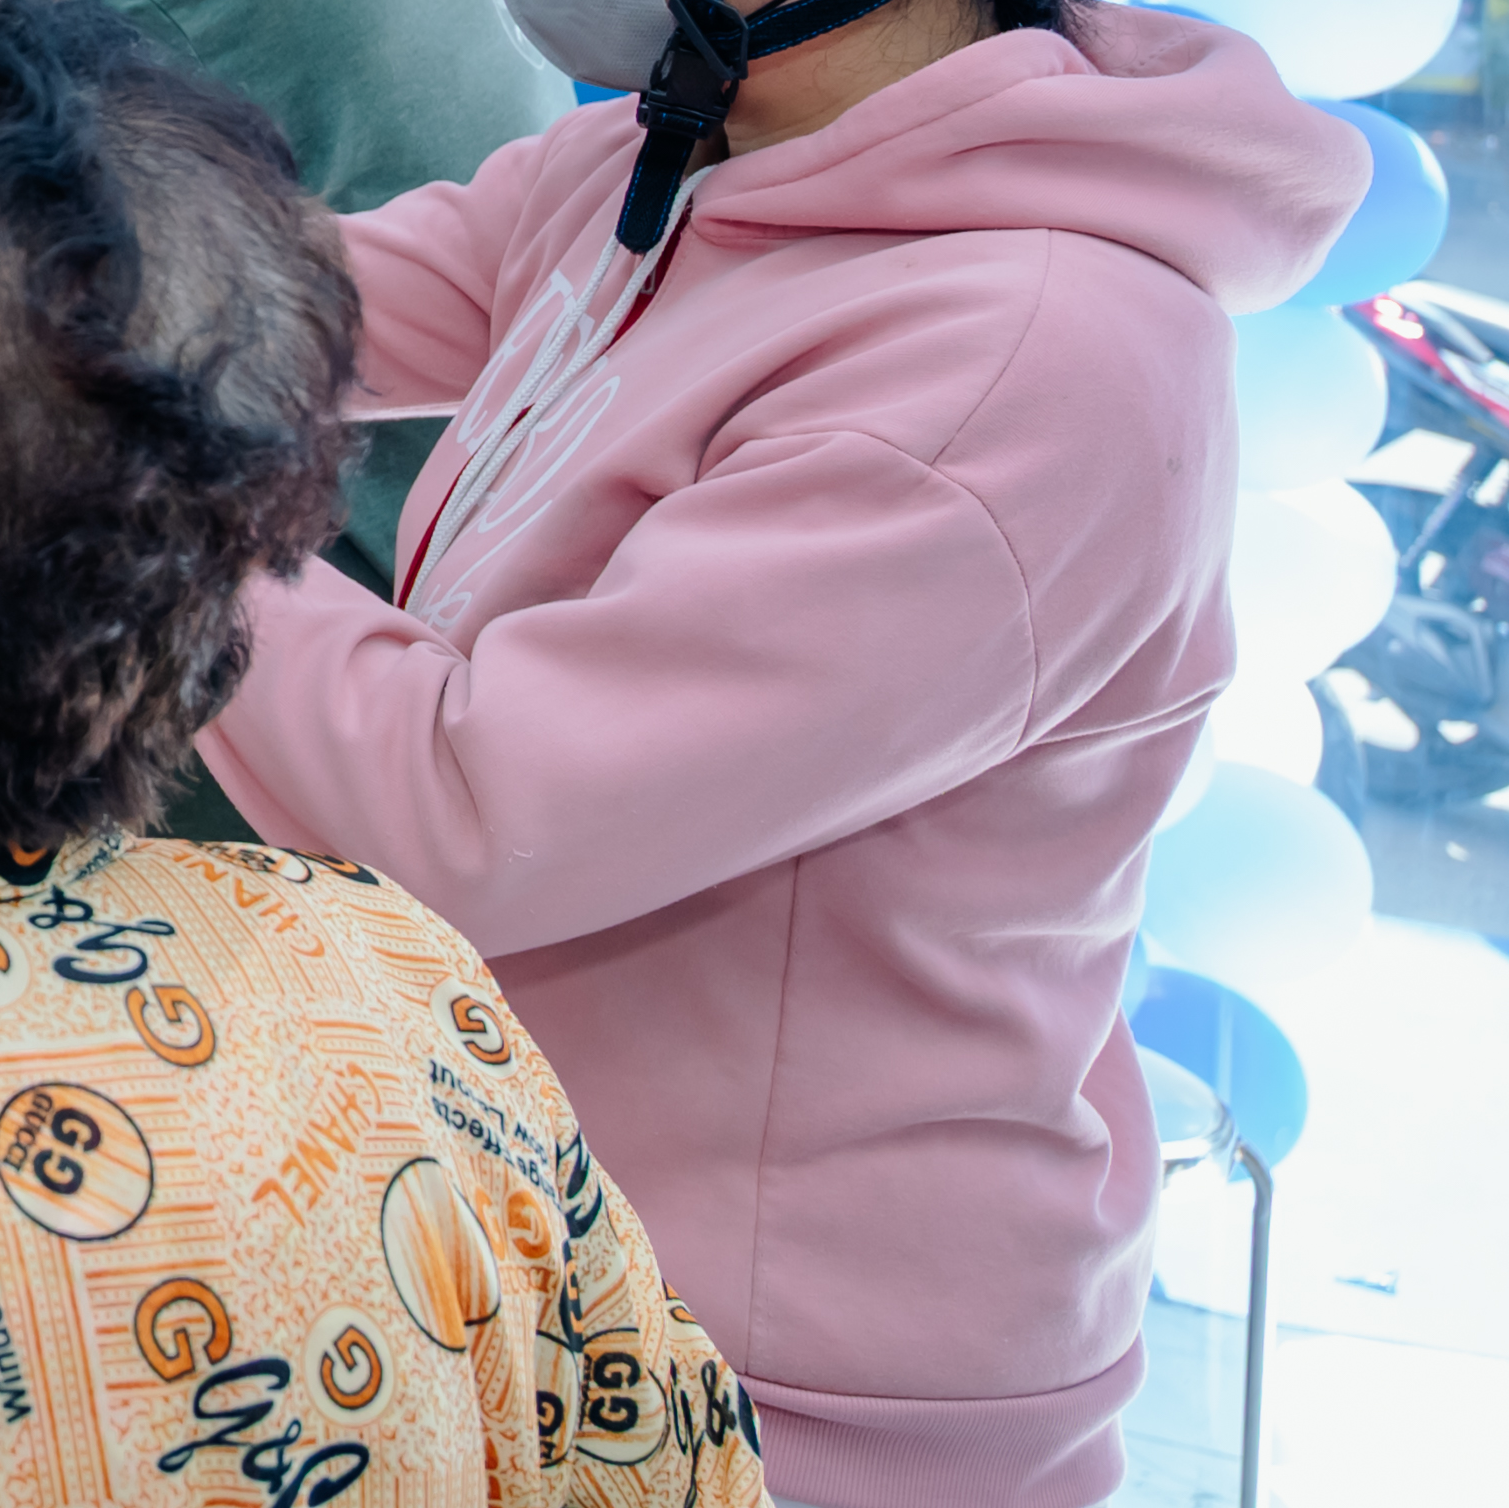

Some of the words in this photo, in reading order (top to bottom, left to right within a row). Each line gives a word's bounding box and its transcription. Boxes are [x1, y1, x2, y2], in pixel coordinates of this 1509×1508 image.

[125, 984, 217, 1068] G
[251, 1061, 382, 1228] CHANEL
[134, 1276, 233, 1383] G
[319, 1324, 383, 1411] G
